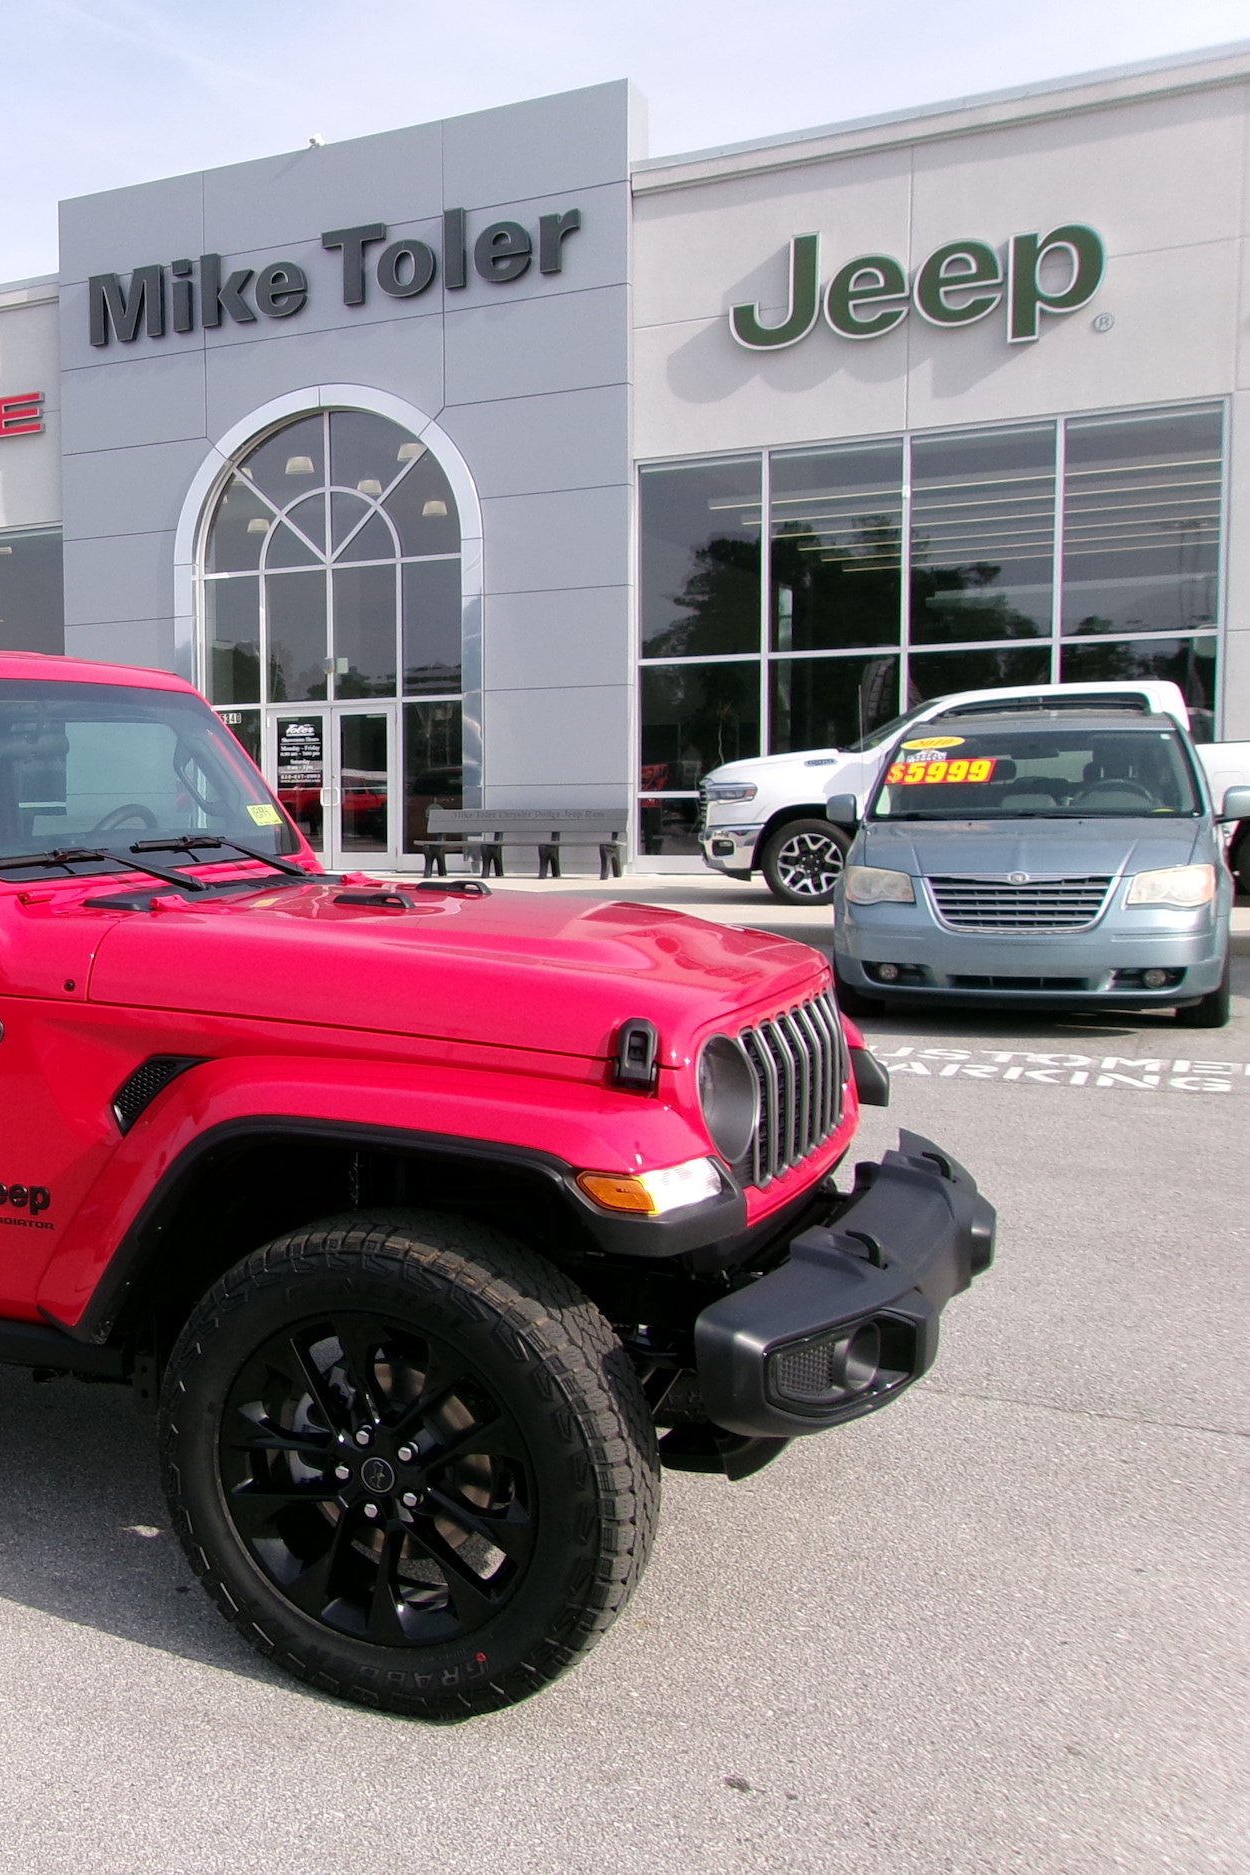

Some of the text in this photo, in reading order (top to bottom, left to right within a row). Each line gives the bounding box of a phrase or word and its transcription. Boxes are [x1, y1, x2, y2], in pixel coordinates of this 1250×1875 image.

[88, 207, 582, 346] Mike Toler
[729, 222, 1109, 350] Jeep
[887, 760, 992, 783] $5999
[868, 1045, 1250, 1076] USTOME
[878, 1060, 1232, 1092] ARKING
